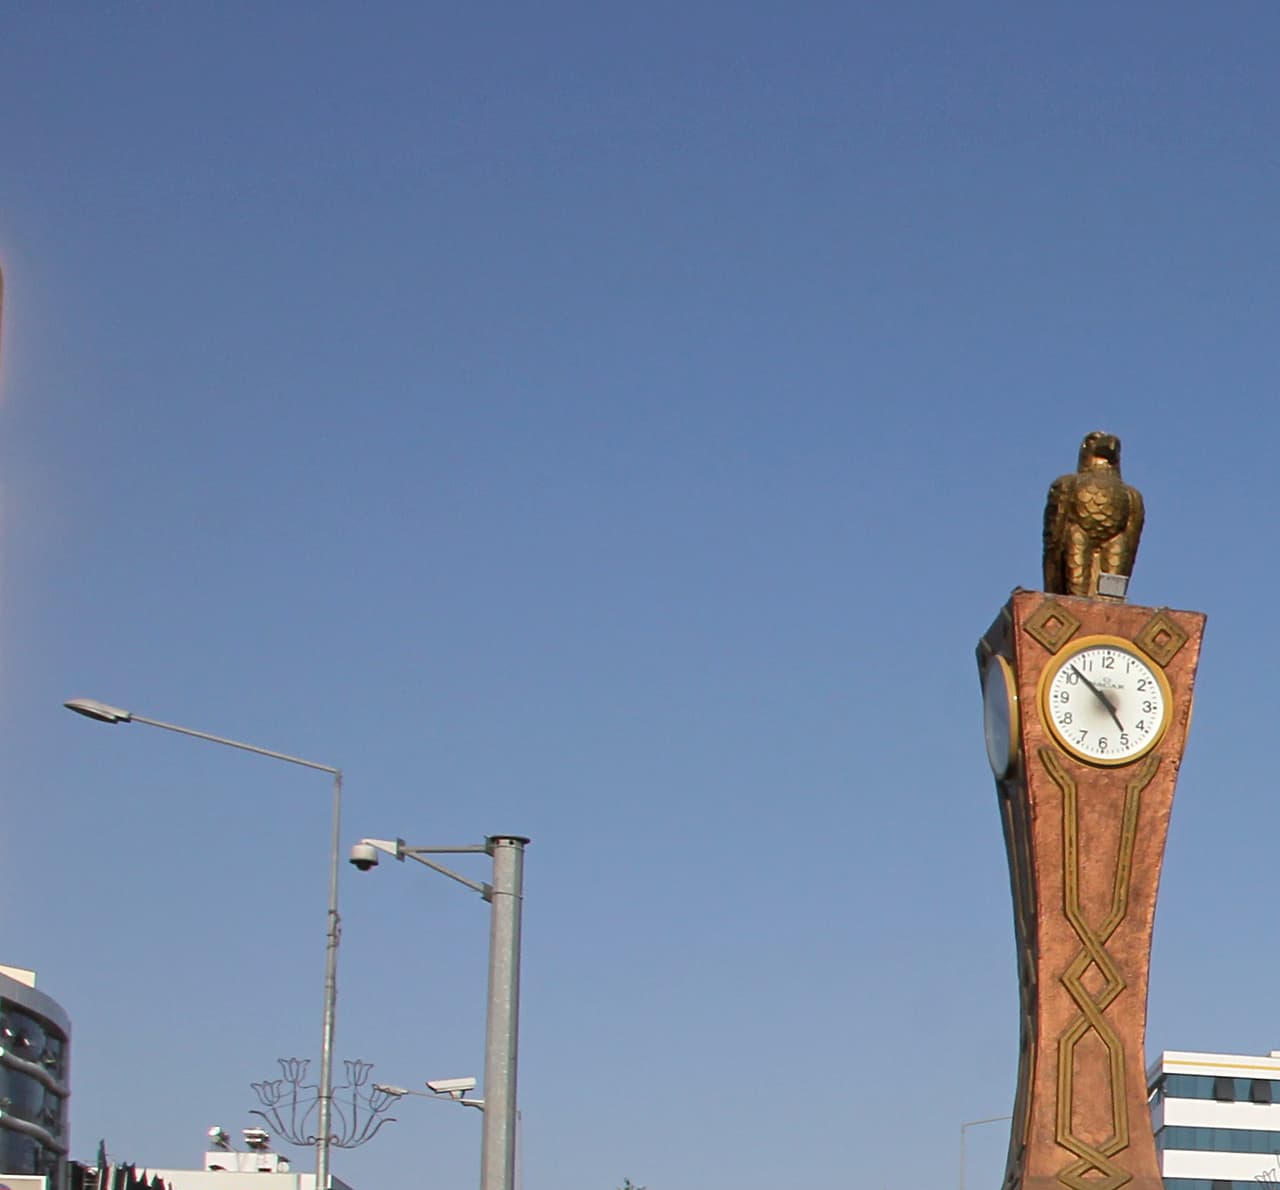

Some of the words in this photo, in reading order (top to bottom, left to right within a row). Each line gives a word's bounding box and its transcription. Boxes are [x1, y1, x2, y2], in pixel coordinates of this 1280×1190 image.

[1083, 658, 1092, 672] 11
[1102, 656, 1114, 669] 12
[1126, 661, 1130, 674] 1
[1066, 672, 1079, 685] 10
[1137, 679, 1147, 691] 2
[1060, 691, 1070, 703] 9
[1142, 701, 1152, 713] 3
[1063, 712, 1073, 724] 8
[1136, 720, 1144, 731] 4
[1080, 730, 1088, 741] 7
[1120, 734, 1129, 745] 5
[1099, 737, 1108, 749] 6
